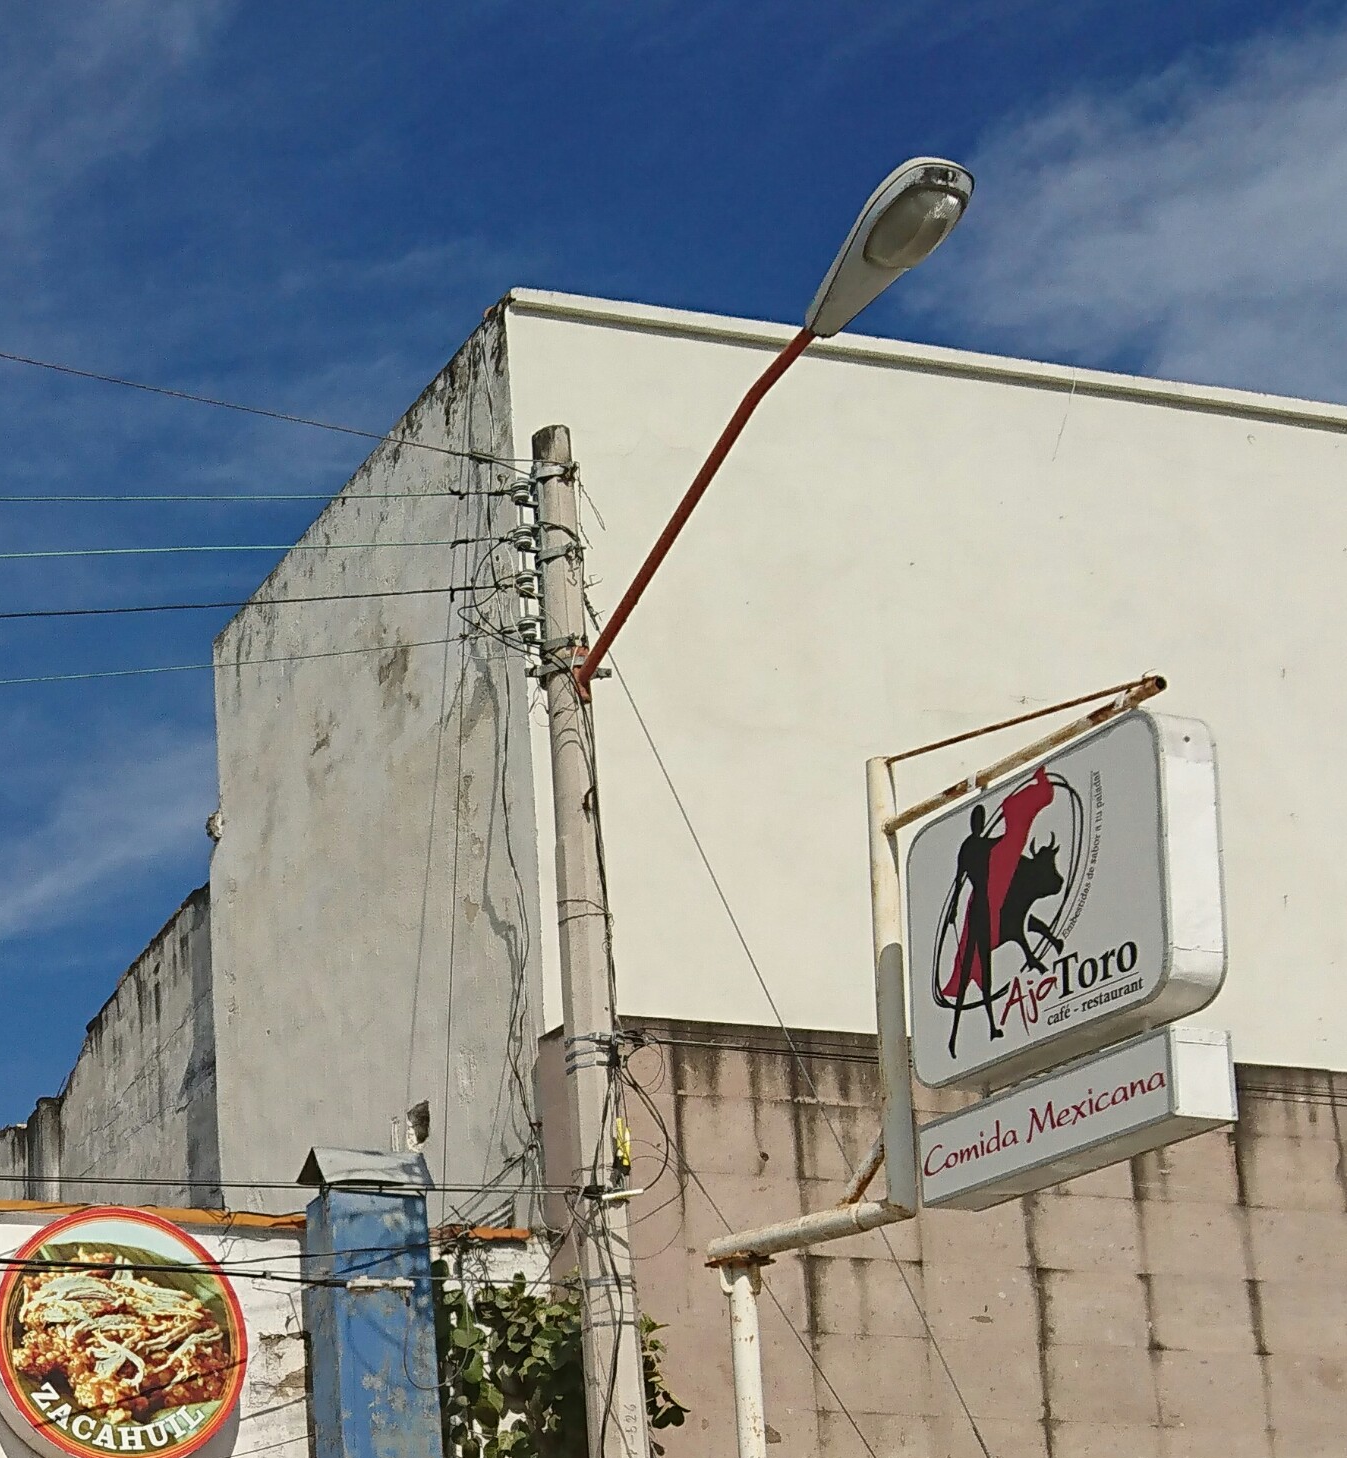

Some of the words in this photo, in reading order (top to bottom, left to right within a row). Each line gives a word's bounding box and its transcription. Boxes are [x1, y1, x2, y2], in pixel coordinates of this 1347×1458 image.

[1047, 1004, 1071, 1026] café
[1081, 977, 1145, 1012] restaurant
[923, 1119, 1019, 1177] Comida
[1026, 1071, 1167, 1144] Mexicana
[30, 1381, 205, 1451] ZACAHUIL
